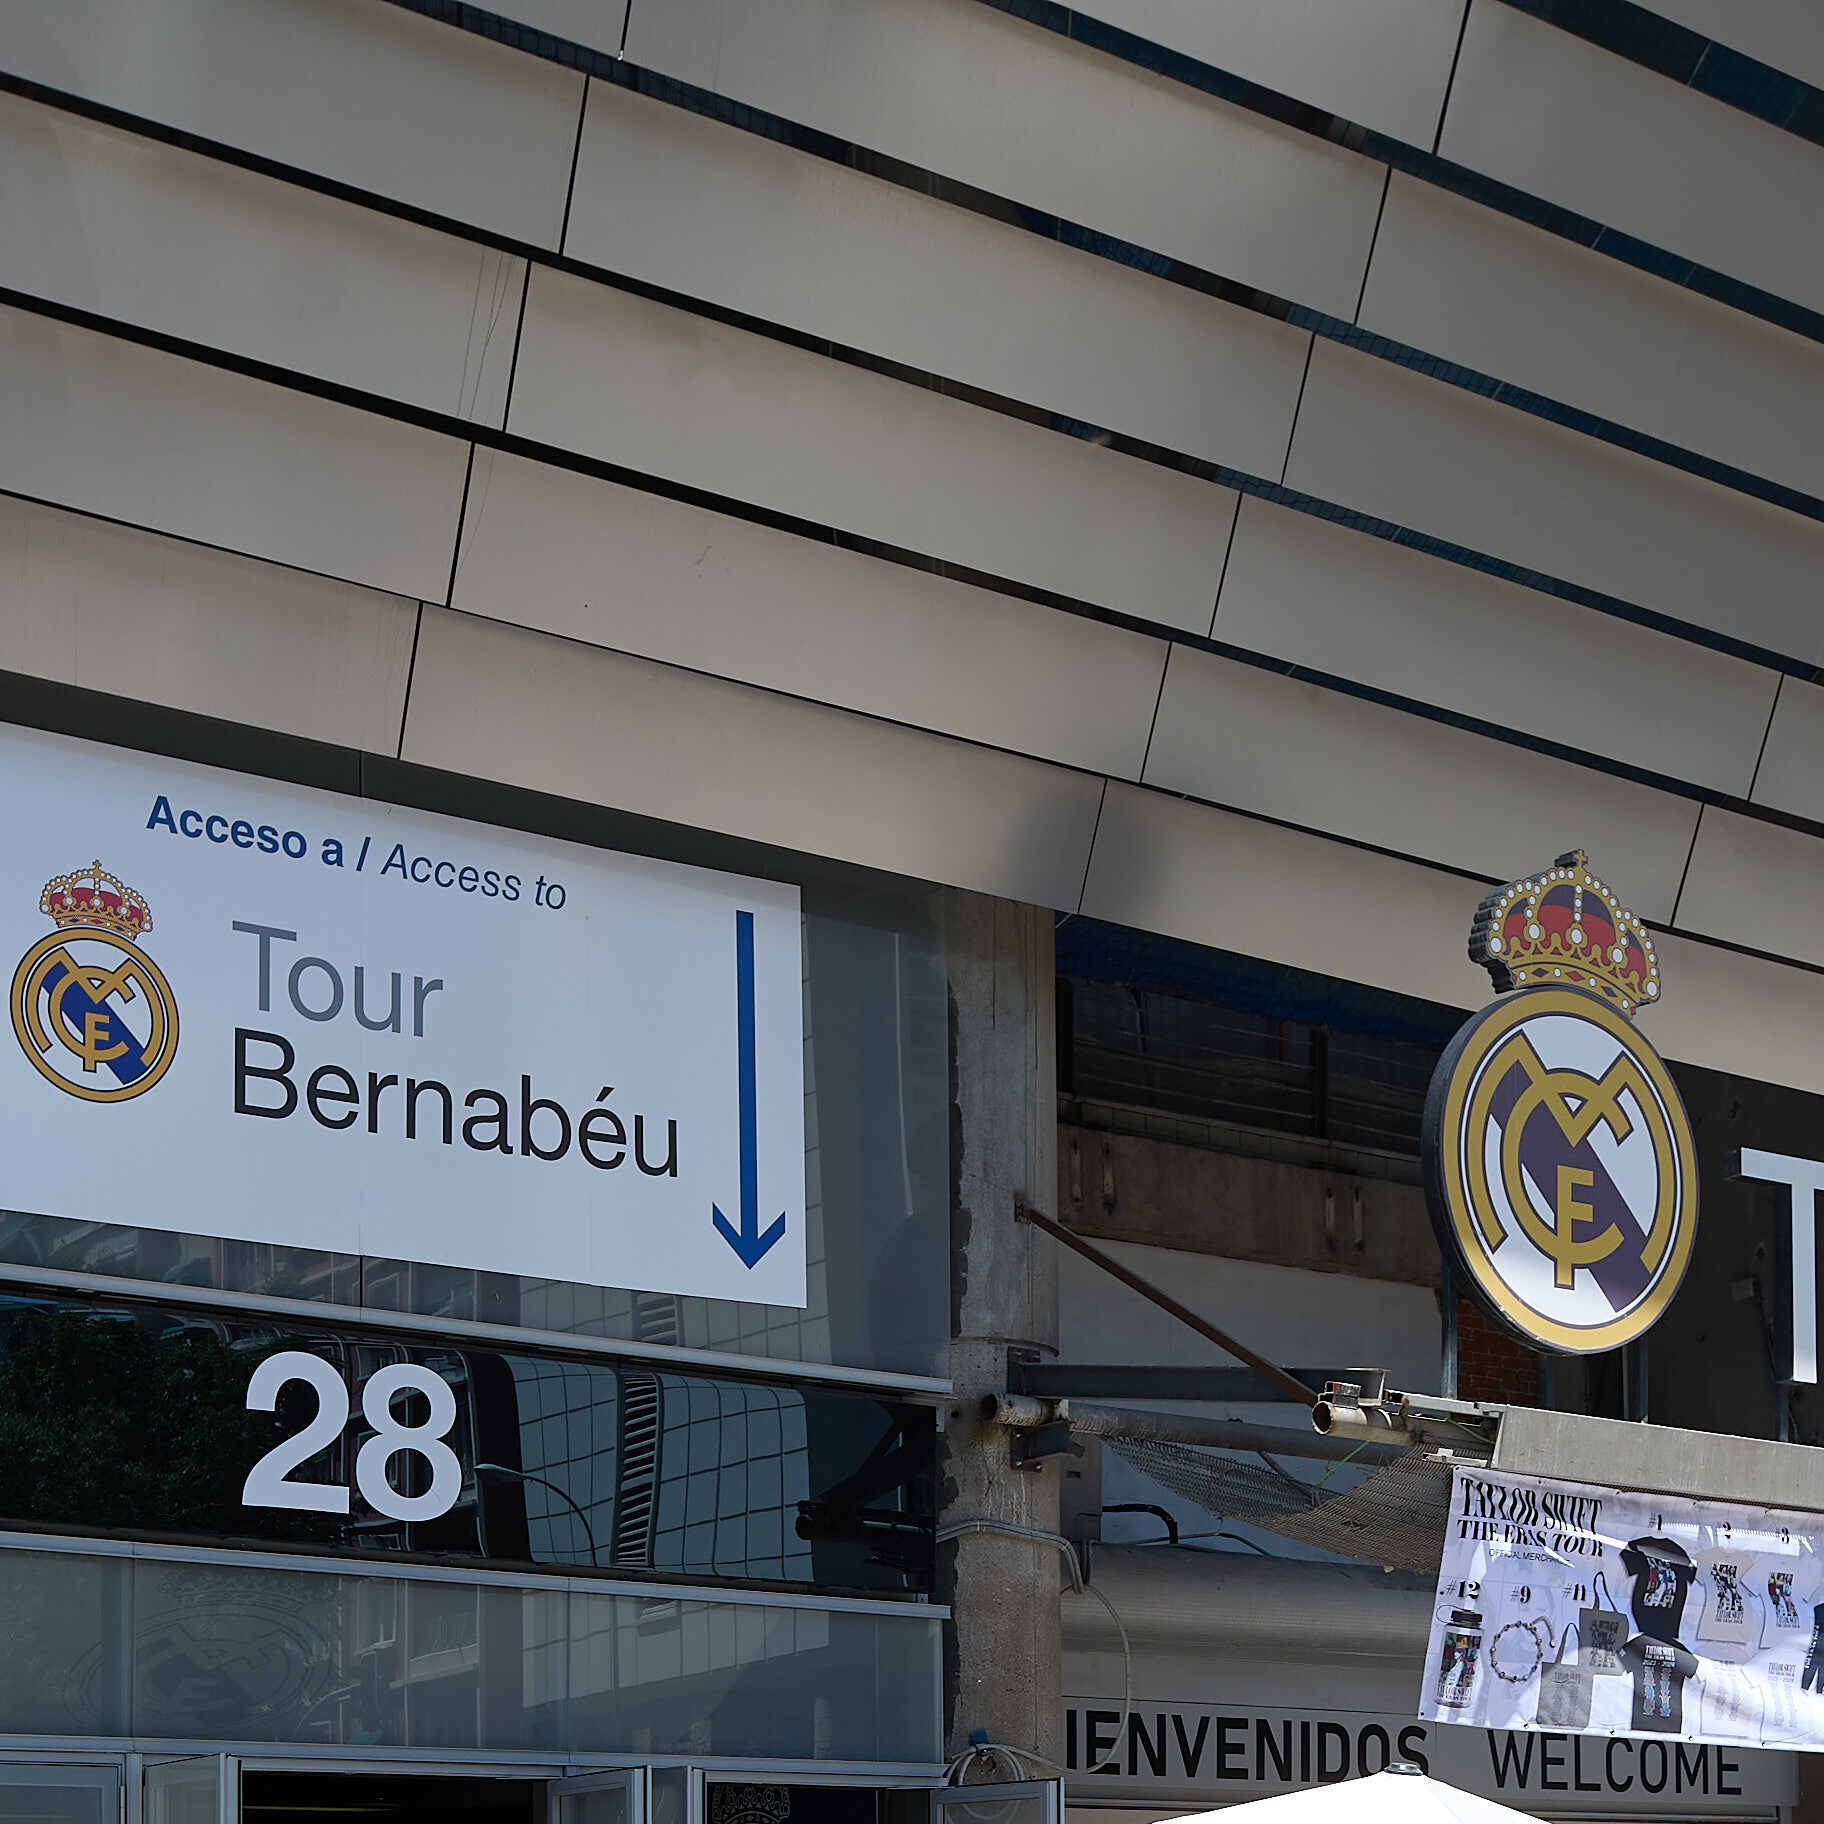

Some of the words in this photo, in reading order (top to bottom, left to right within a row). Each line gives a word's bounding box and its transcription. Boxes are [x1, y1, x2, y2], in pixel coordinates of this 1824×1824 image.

[144, 794, 307, 861] Acceso
[320, 831, 345, 868] a
[380, 842, 521, 903] Access
[535, 875, 567, 911] to
[230, 918, 444, 1039] Tour
[232, 1026, 679, 1179] Bernabéu
[241, 1350, 463, 1522] 28
[1456, 1519, 1499, 1542] THE
[1504, 1525, 1547, 1548] ERAS
[1552, 1533, 1603, 1557] TOUR
[1460, 1477, 1539, 1527] TAYLOR
[1542, 1491, 1603, 1535] SWIFT
[1445, 1580, 1481, 1599] #12
[1510, 1585, 1531, 1604] #9
[1560, 1583, 1586, 1601] #11
[1066, 1707, 1429, 1784] IENVENIDOS
[1487, 1729, 1743, 1797] WELCOME
